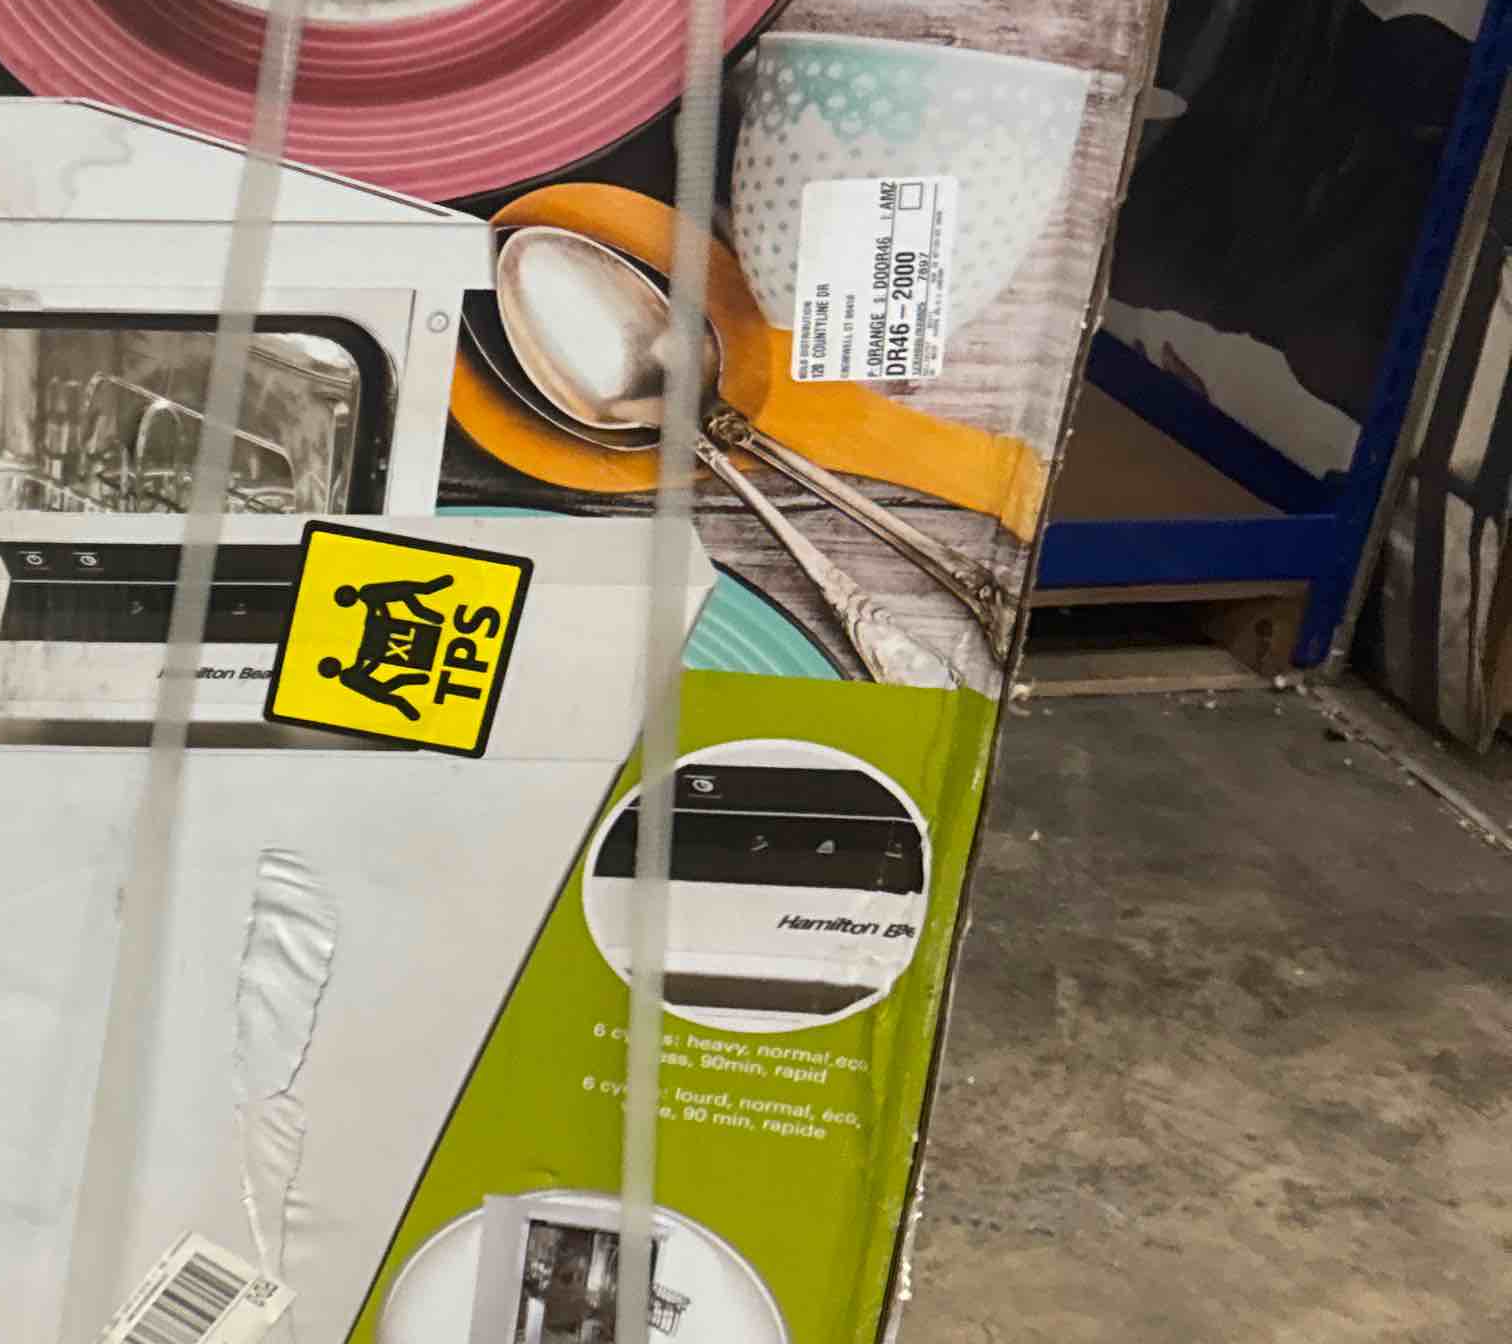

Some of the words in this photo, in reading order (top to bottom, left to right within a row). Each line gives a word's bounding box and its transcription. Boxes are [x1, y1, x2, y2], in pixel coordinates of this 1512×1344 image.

[879, 181, 896, 209] AMZ
[873, 236, 893, 289] DOOR46
[811, 300, 829, 359] COUNTYLINE
[866, 312, 886, 367] ORANGE
[384, 627, 419, 660] XL
[433, 602, 502, 706] TPS
[777, 914, 880, 936] Hamilton
[775, 1066, 828, 1085] rapid
[675, 1087, 732, 1110] lourd,
[683, 1105, 708, 1123] 90
[763, 1118, 827, 1140] rapide
